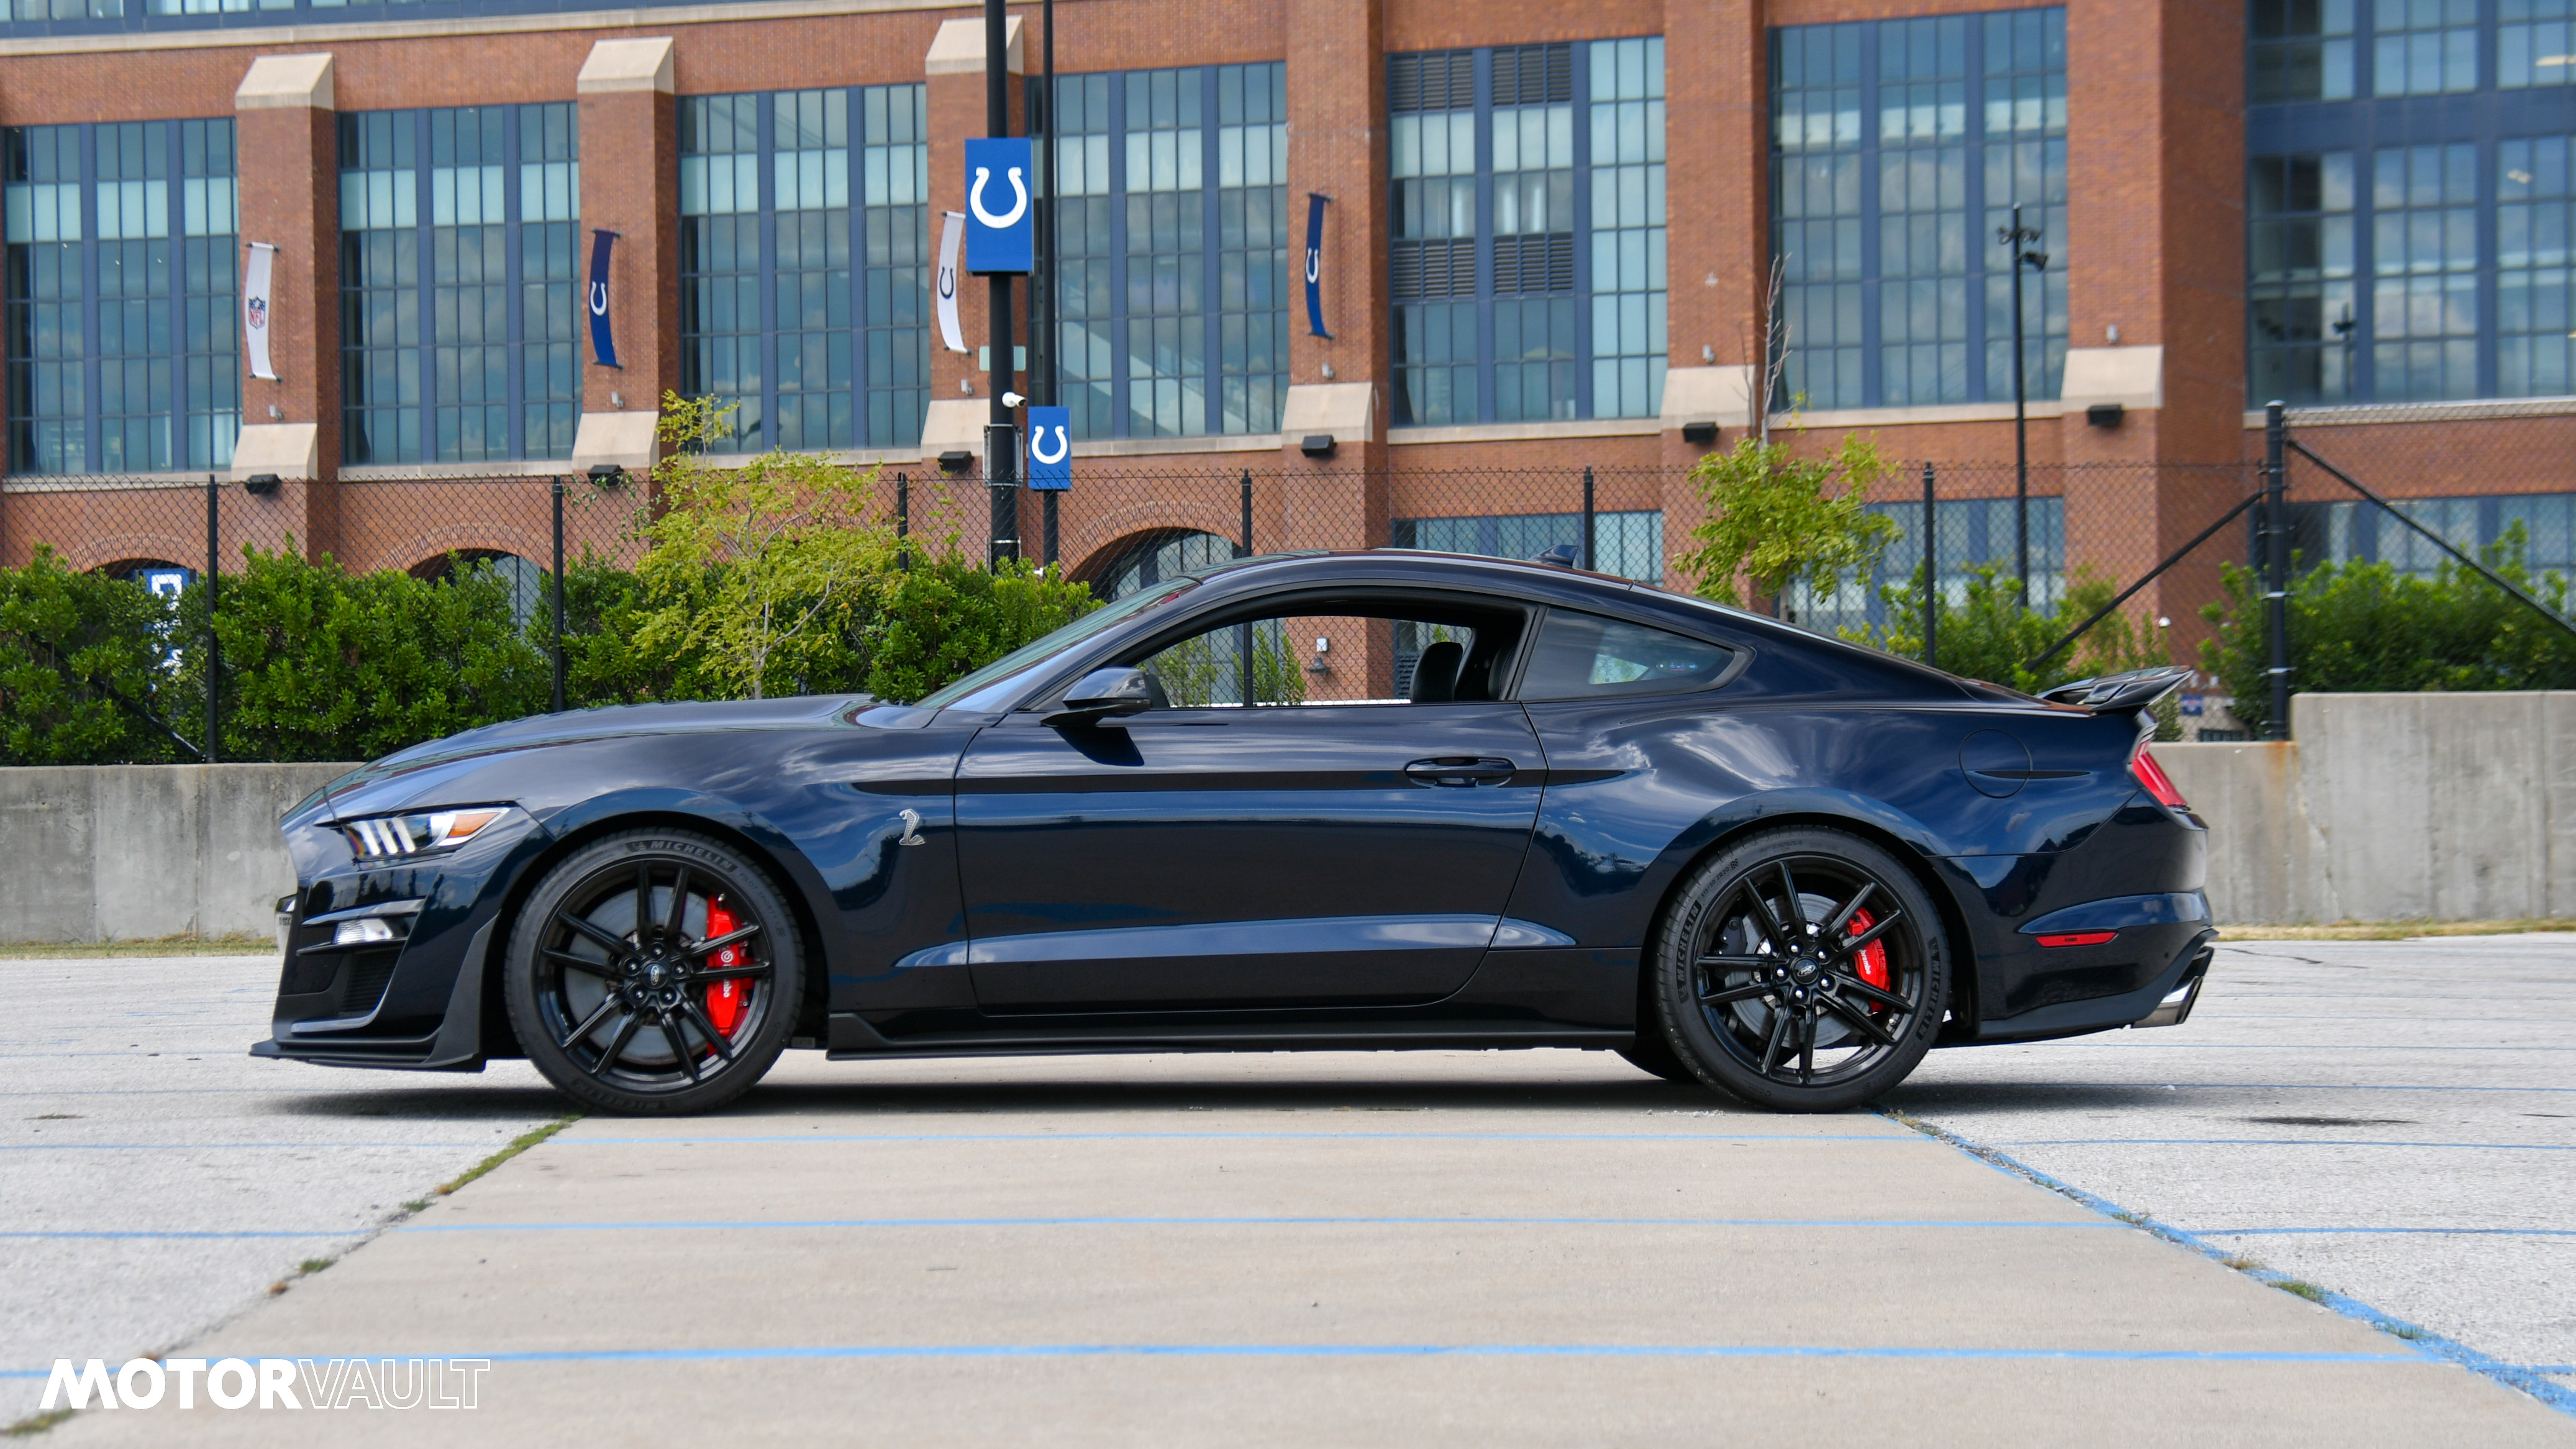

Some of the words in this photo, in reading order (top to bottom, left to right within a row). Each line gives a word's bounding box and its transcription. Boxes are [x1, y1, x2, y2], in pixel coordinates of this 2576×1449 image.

[650, 841, 733, 869] MICHELIN
[1716, 867, 1729, 881] ZR20
[1677, 906, 1700, 984] MICHELIN
[1860, 949, 1872, 974] brembo
[1921, 964, 1941, 1035] MICHELIN
